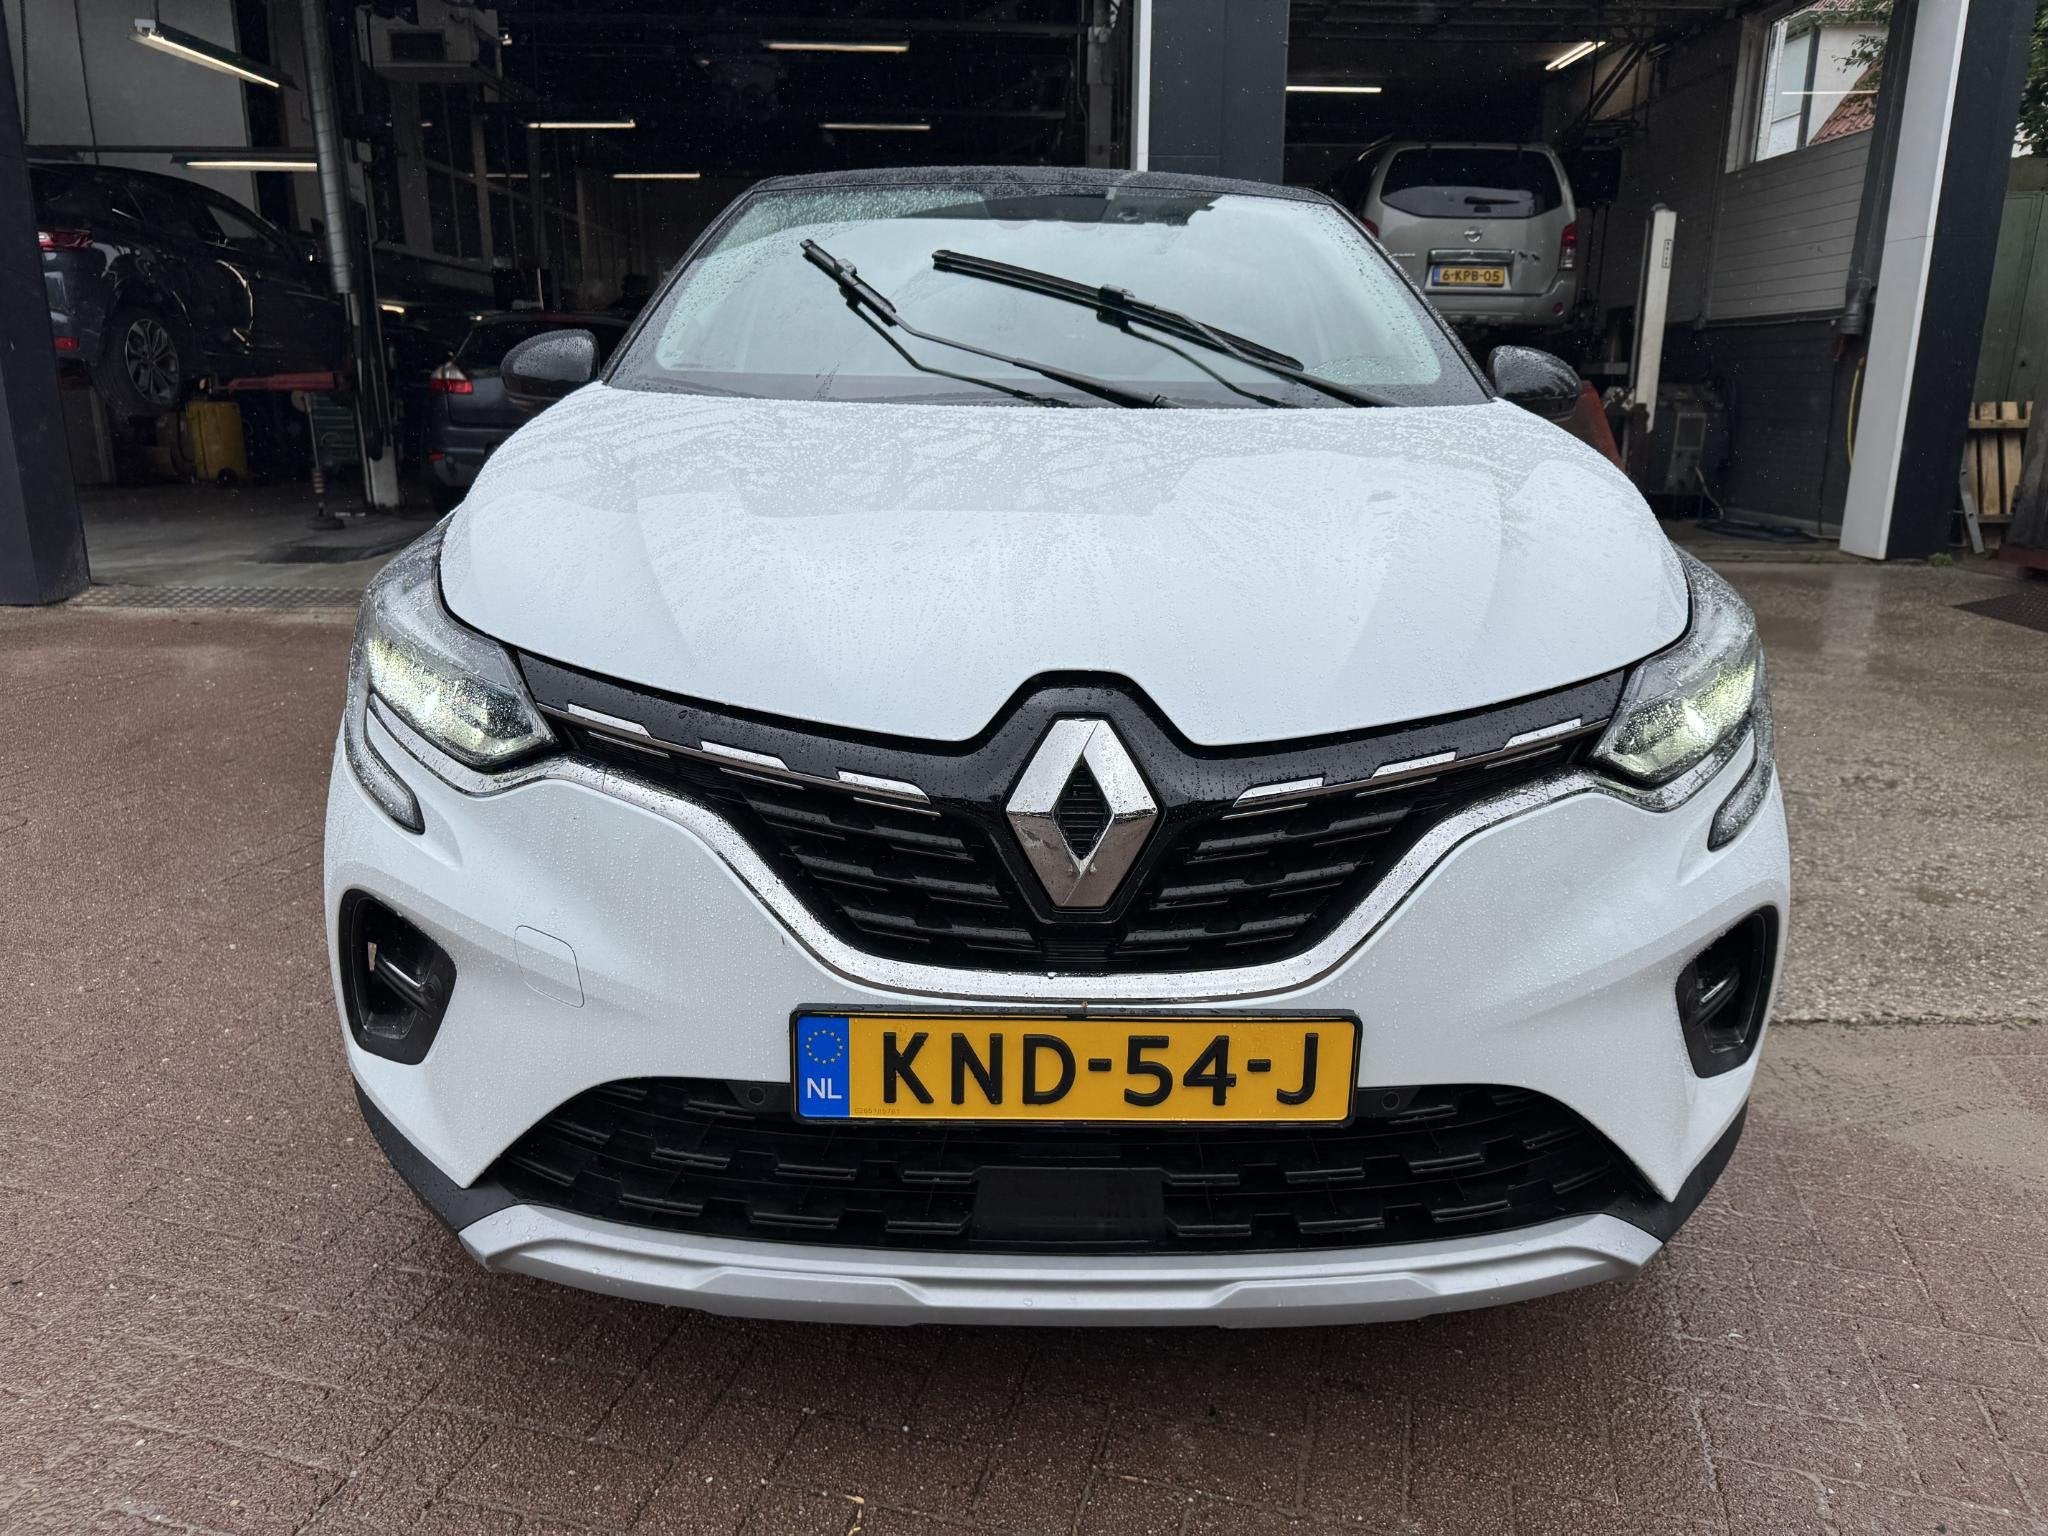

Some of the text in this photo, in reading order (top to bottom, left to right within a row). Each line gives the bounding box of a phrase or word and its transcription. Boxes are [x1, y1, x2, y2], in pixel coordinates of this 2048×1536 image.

[1442, 270, 1501, 282] 6-KPB-05
[883, 1031, 1319, 1106] KND-54-J
[807, 1077, 842, 1099] NL
